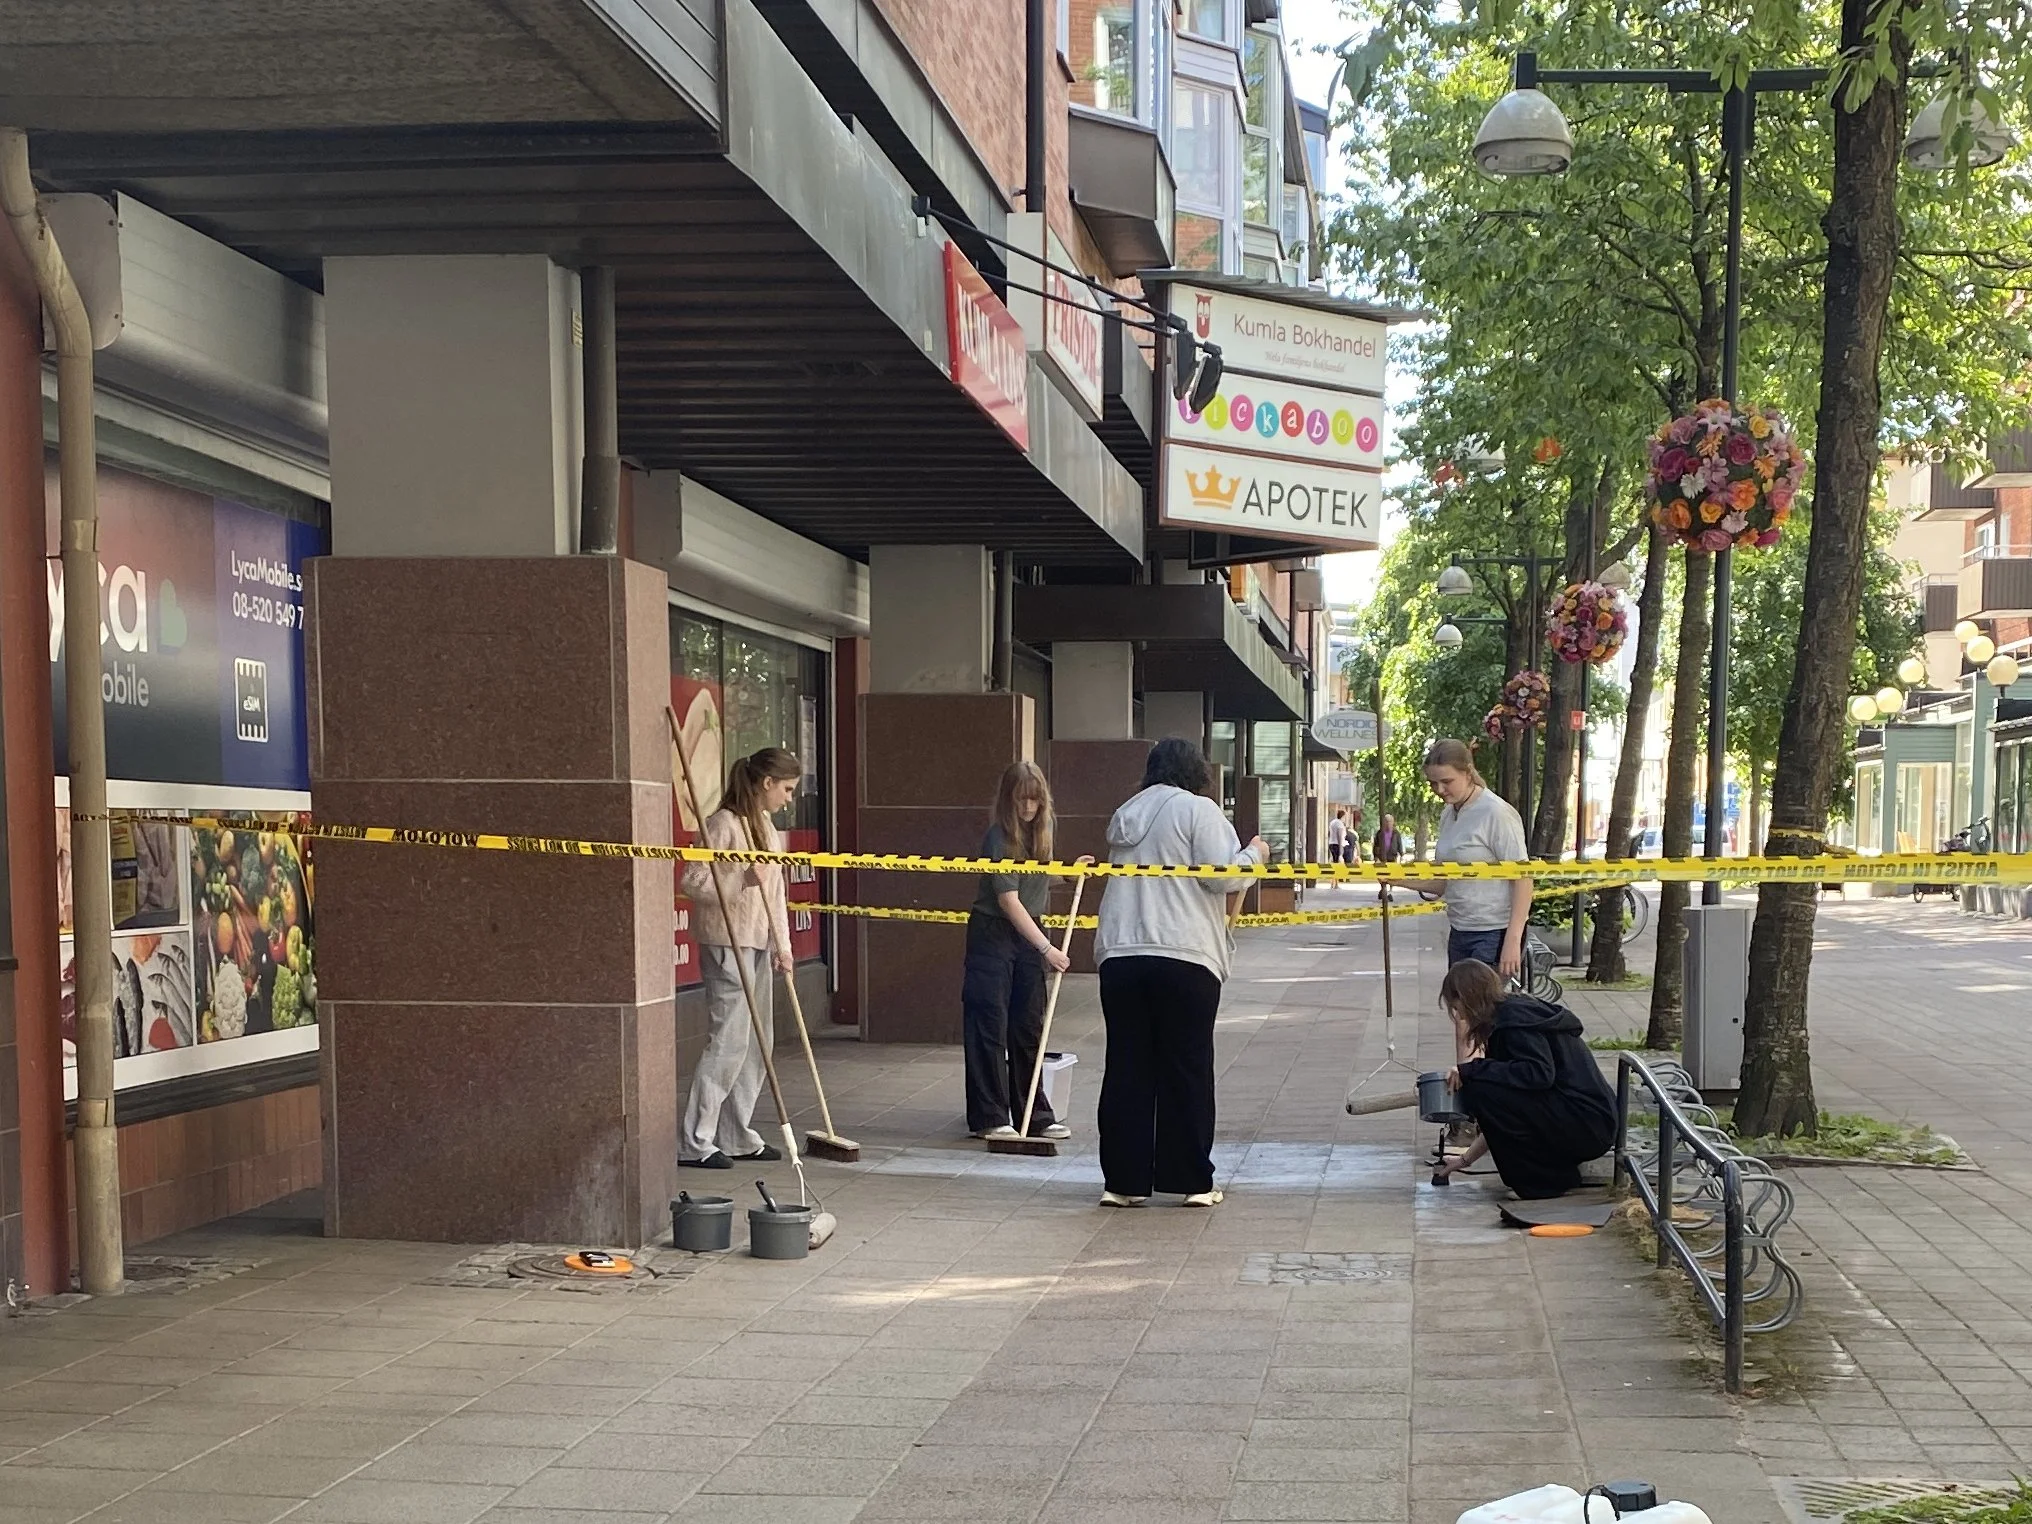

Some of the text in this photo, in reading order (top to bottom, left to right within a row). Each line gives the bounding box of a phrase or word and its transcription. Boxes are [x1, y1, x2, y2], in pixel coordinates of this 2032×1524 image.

[957, 282, 1001, 391] KUMLA
[1233, 312, 1377, 359] Kumla Bokhandel
[1242, 477, 1369, 529] APOTEK
[230, 549, 303, 593] LycaMobile.s
[231, 591, 305, 631] 08-520 549 7
[101, 660, 150, 708] obile
[242, 695, 262, 713] eSIM
[1326, 718, 1378, 729] NORDIC
